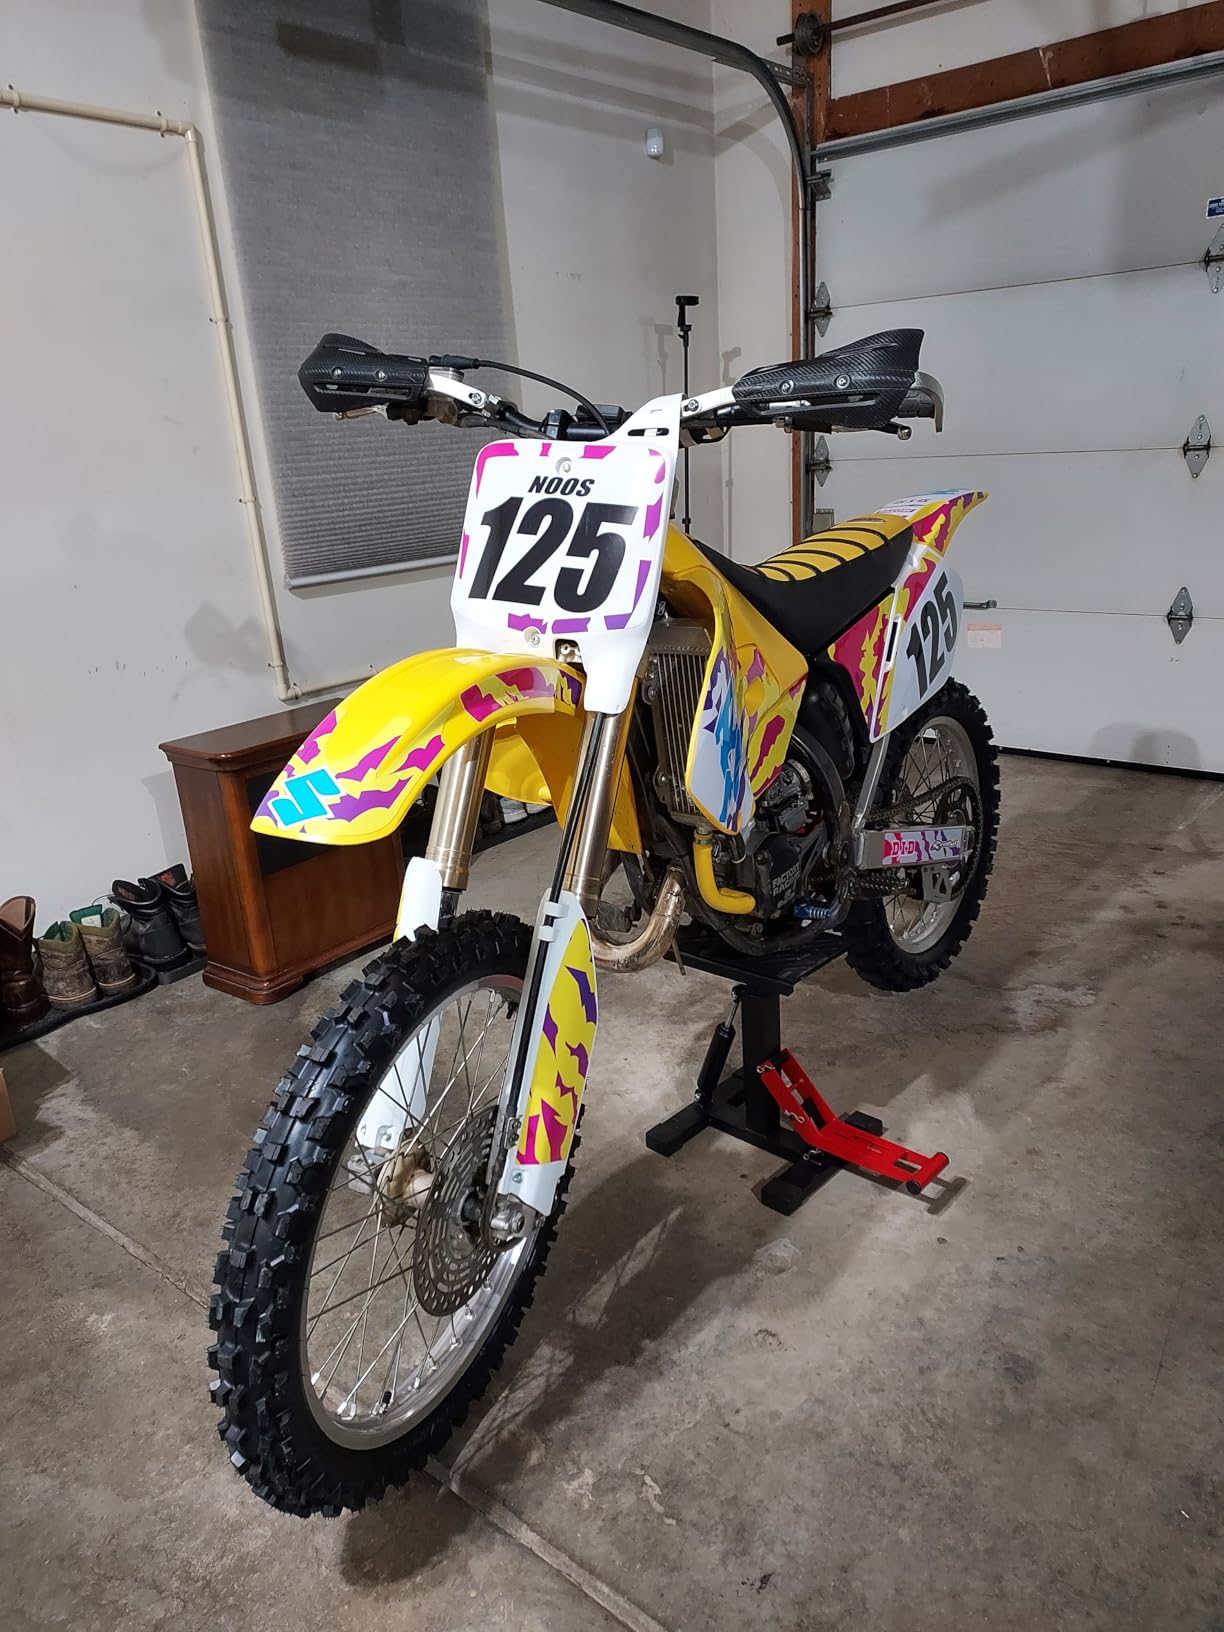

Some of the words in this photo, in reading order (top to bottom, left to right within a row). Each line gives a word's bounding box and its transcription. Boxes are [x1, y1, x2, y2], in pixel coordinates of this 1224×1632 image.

[528, 475, 595, 497] NOOS
[468, 496, 639, 613] 125
[906, 571, 957, 700] 125
[772, 861, 800, 889] FACTORY
[772, 870, 800, 897] RACING
